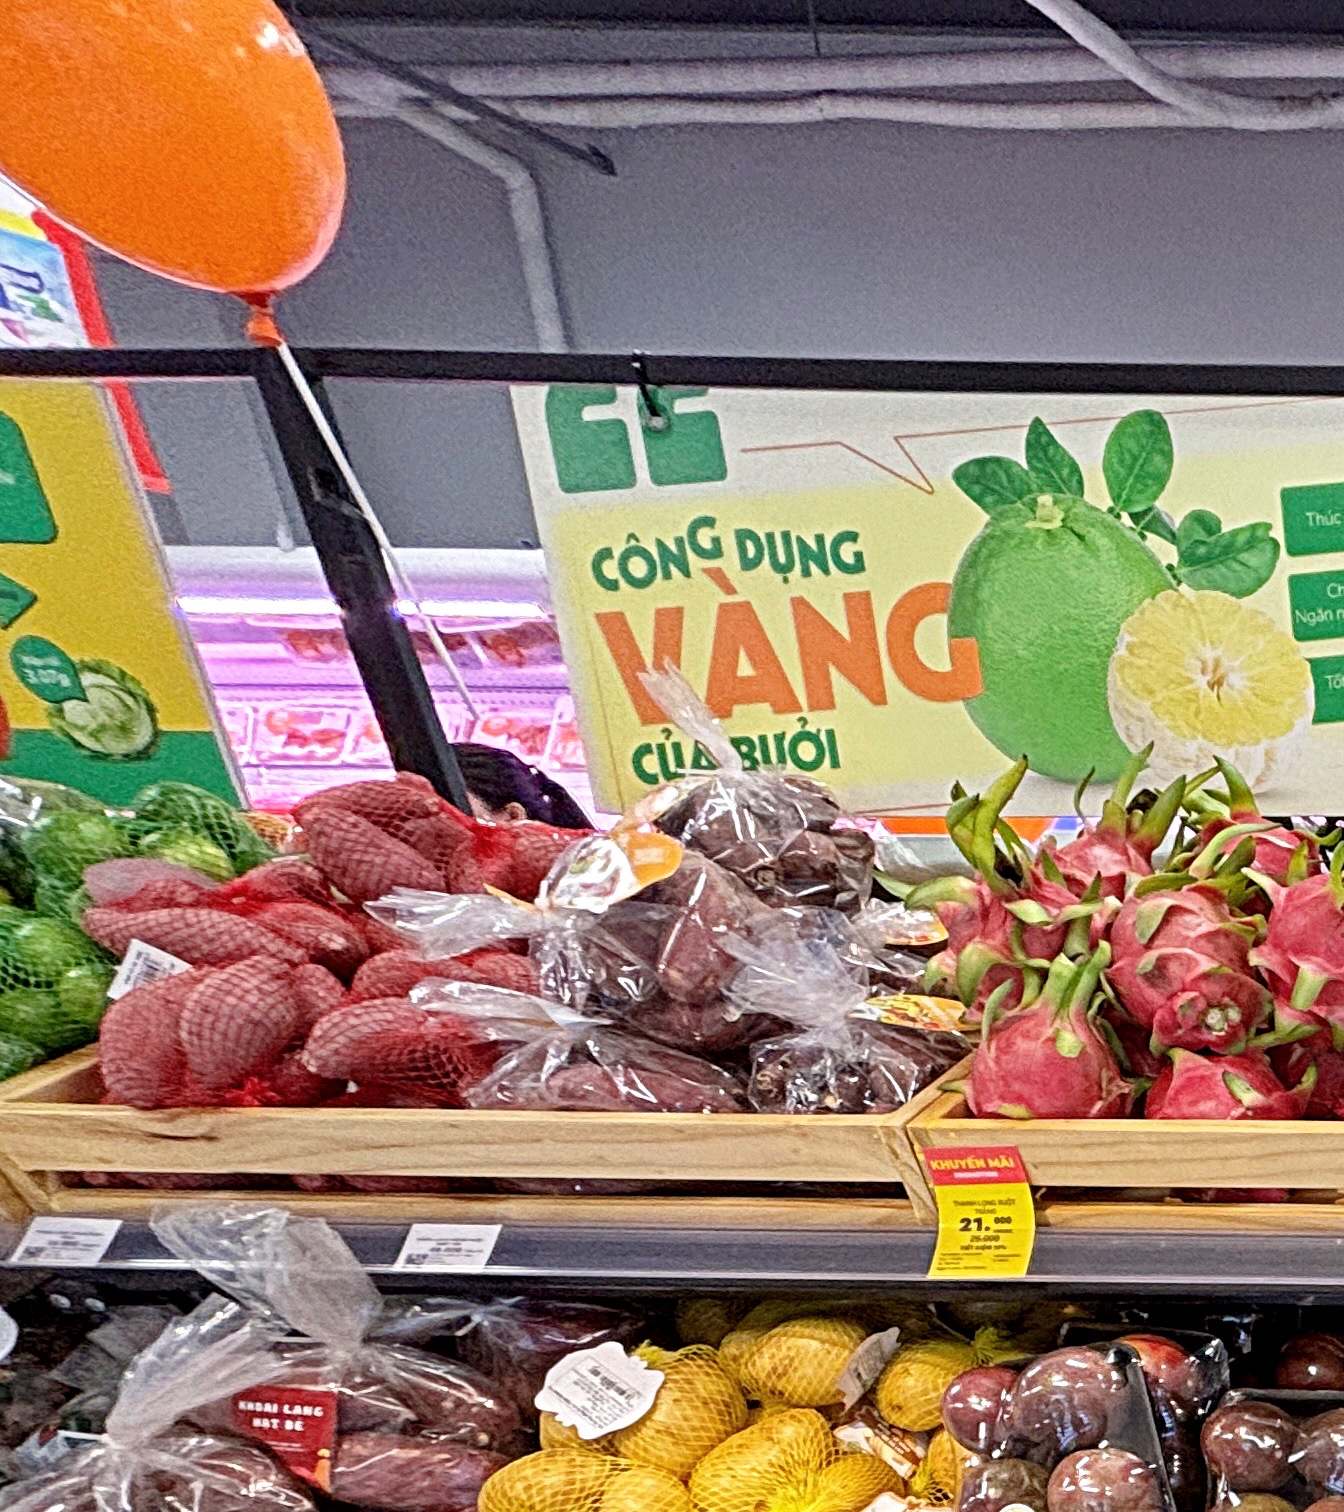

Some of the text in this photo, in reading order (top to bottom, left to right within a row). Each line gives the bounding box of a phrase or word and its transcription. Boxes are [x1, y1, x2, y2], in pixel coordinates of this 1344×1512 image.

[1306, 509, 1341, 527] Thúc
[592, 516, 866, 592] CÔNG DỤNG
[1295, 607, 1333, 626] Ngăn
[595, 567, 984, 726] VÀNG
[740, 716, 841, 772] BƯỞI
[930, 1156, 986, 1171] KHUYẾN
[283, 1403, 324, 1418] LANG
